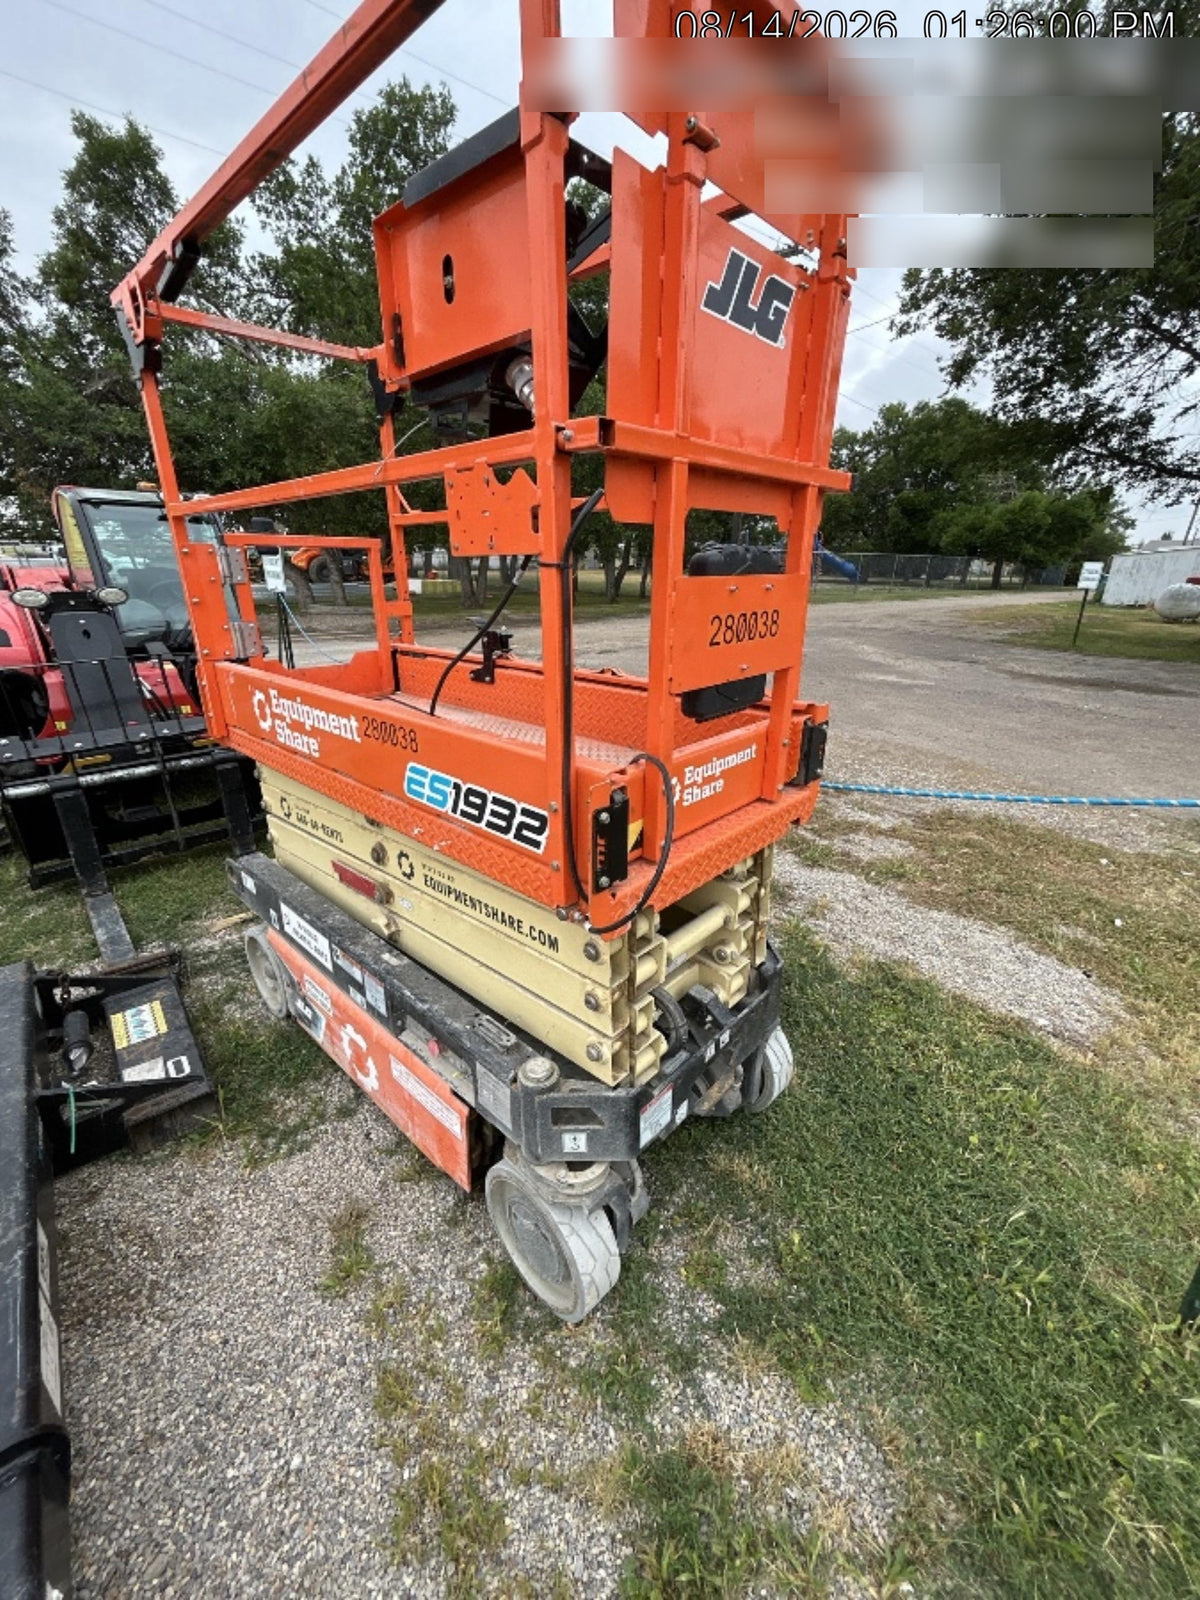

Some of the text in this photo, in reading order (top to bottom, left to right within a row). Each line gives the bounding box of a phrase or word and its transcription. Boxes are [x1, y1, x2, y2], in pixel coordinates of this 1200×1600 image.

[701, 246, 797, 350] JLG
[708, 608, 780, 649] 280038
[268, 688, 362, 743] Equipment
[361, 715, 420, 754] 280038
[274, 718, 321, 758] Share
[684, 743, 758, 786] Equipment
[405, 763, 549, 851] ES1932
[682, 778, 725, 808] Share
[422, 872, 560, 954] EQUIPMENTSHARE.COM
